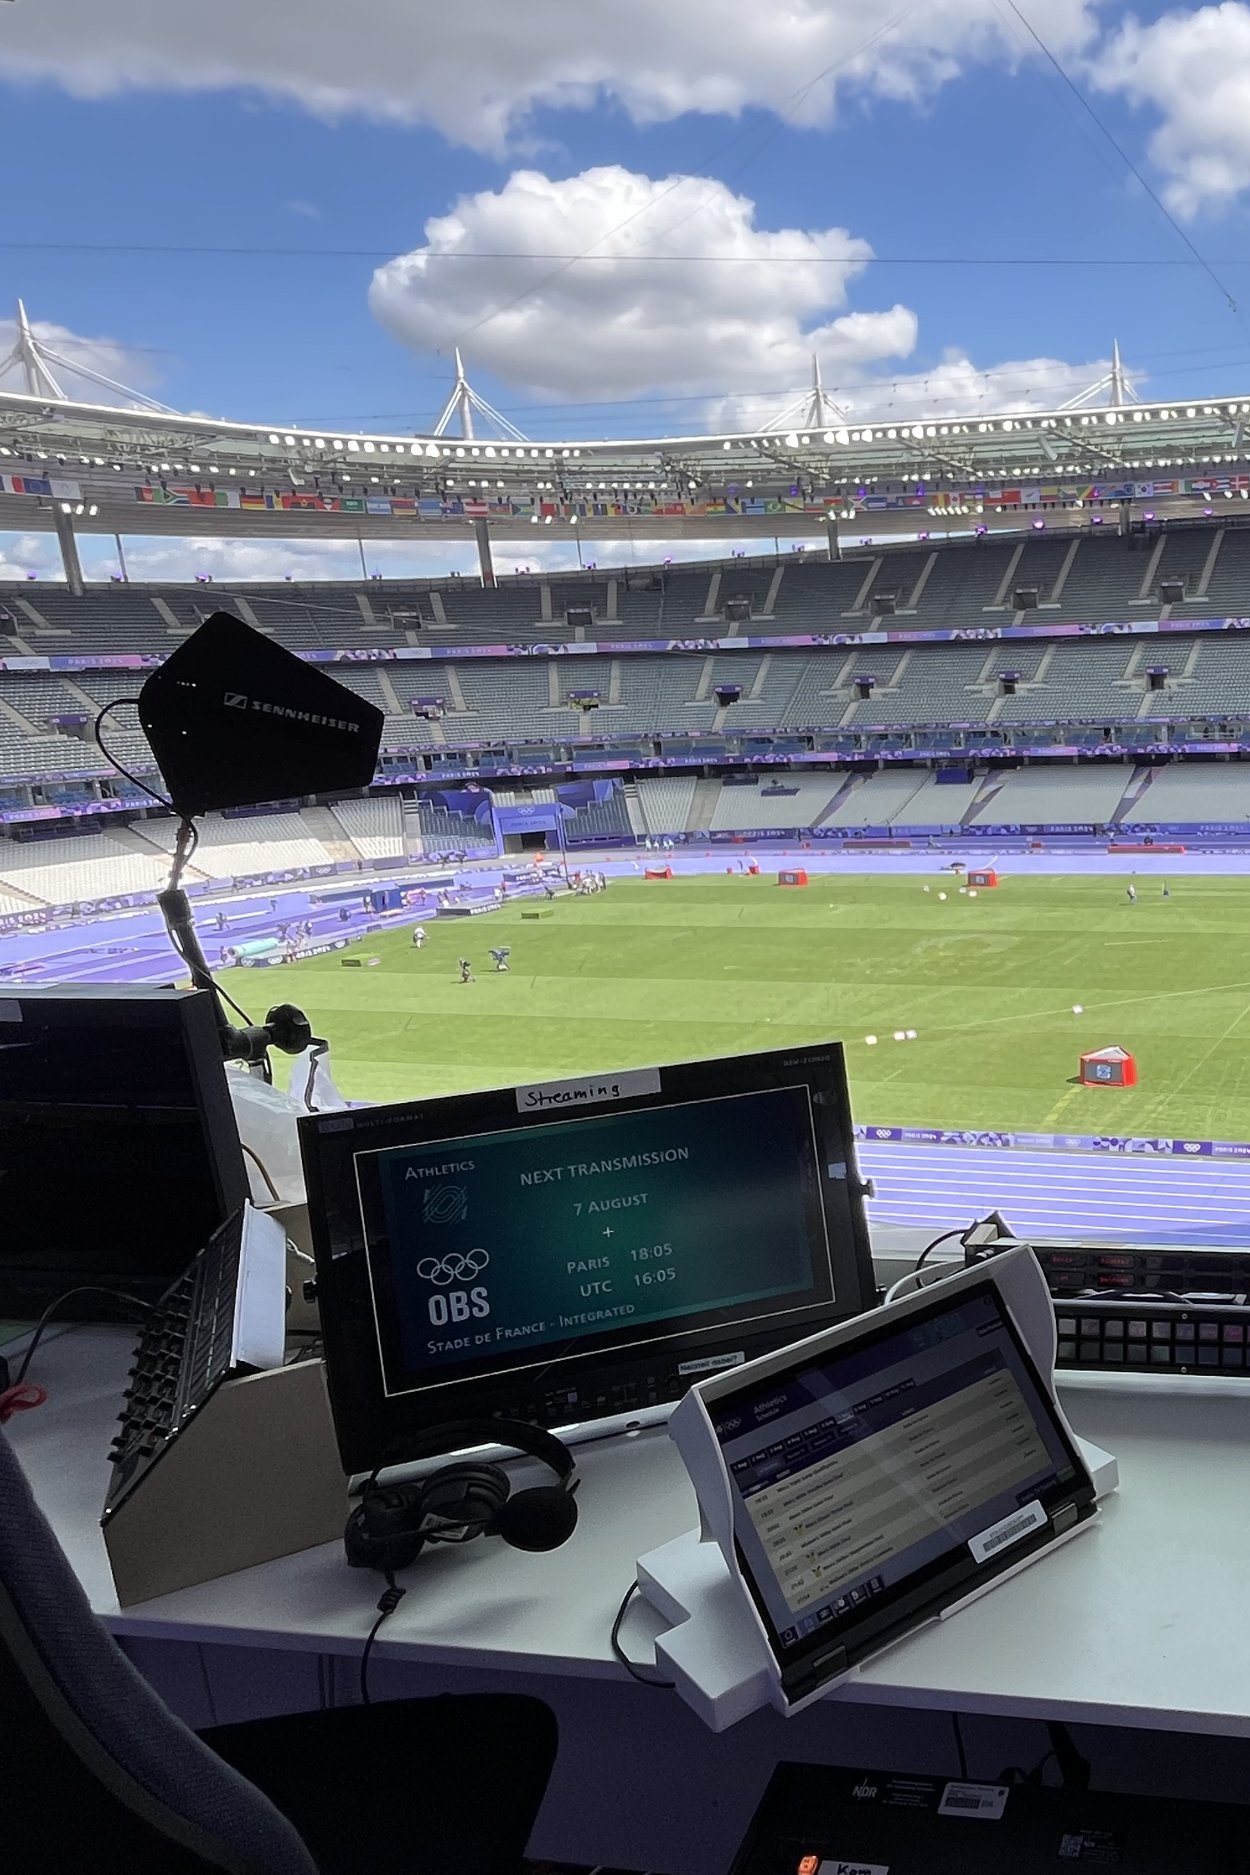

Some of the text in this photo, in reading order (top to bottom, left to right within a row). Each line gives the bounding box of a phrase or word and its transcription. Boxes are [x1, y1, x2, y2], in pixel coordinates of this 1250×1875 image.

[252, 701, 360, 732] SENNHEISER
[18, 911, 47, 923] 2024
[296, 950, 313, 960] ARIS
[525, 1084, 620, 1107] Streaming
[405, 1160, 475, 1180] ATHLETICS
[520, 1147, 690, 1187] NEXT TRANSMISSION
[574, 1193, 649, 1216] 7 AUGUST
[567, 1243, 673, 1274] PARIS 18:05
[580, 1267, 676, 1297] UTC 16:05
[428, 1286, 491, 1326] OBS
[427, 1337, 471, 1354] STADE
[475, 1332, 491, 1345] DE
[496, 1322, 546, 1341] FRANCE
[559, 1304, 635, 1328] INTEGRATED
[753, 1394, 787, 1414] Athletics
[756, 1408, 779, 1421] Schedule
[852, 1782, 877, 1800] NDR
